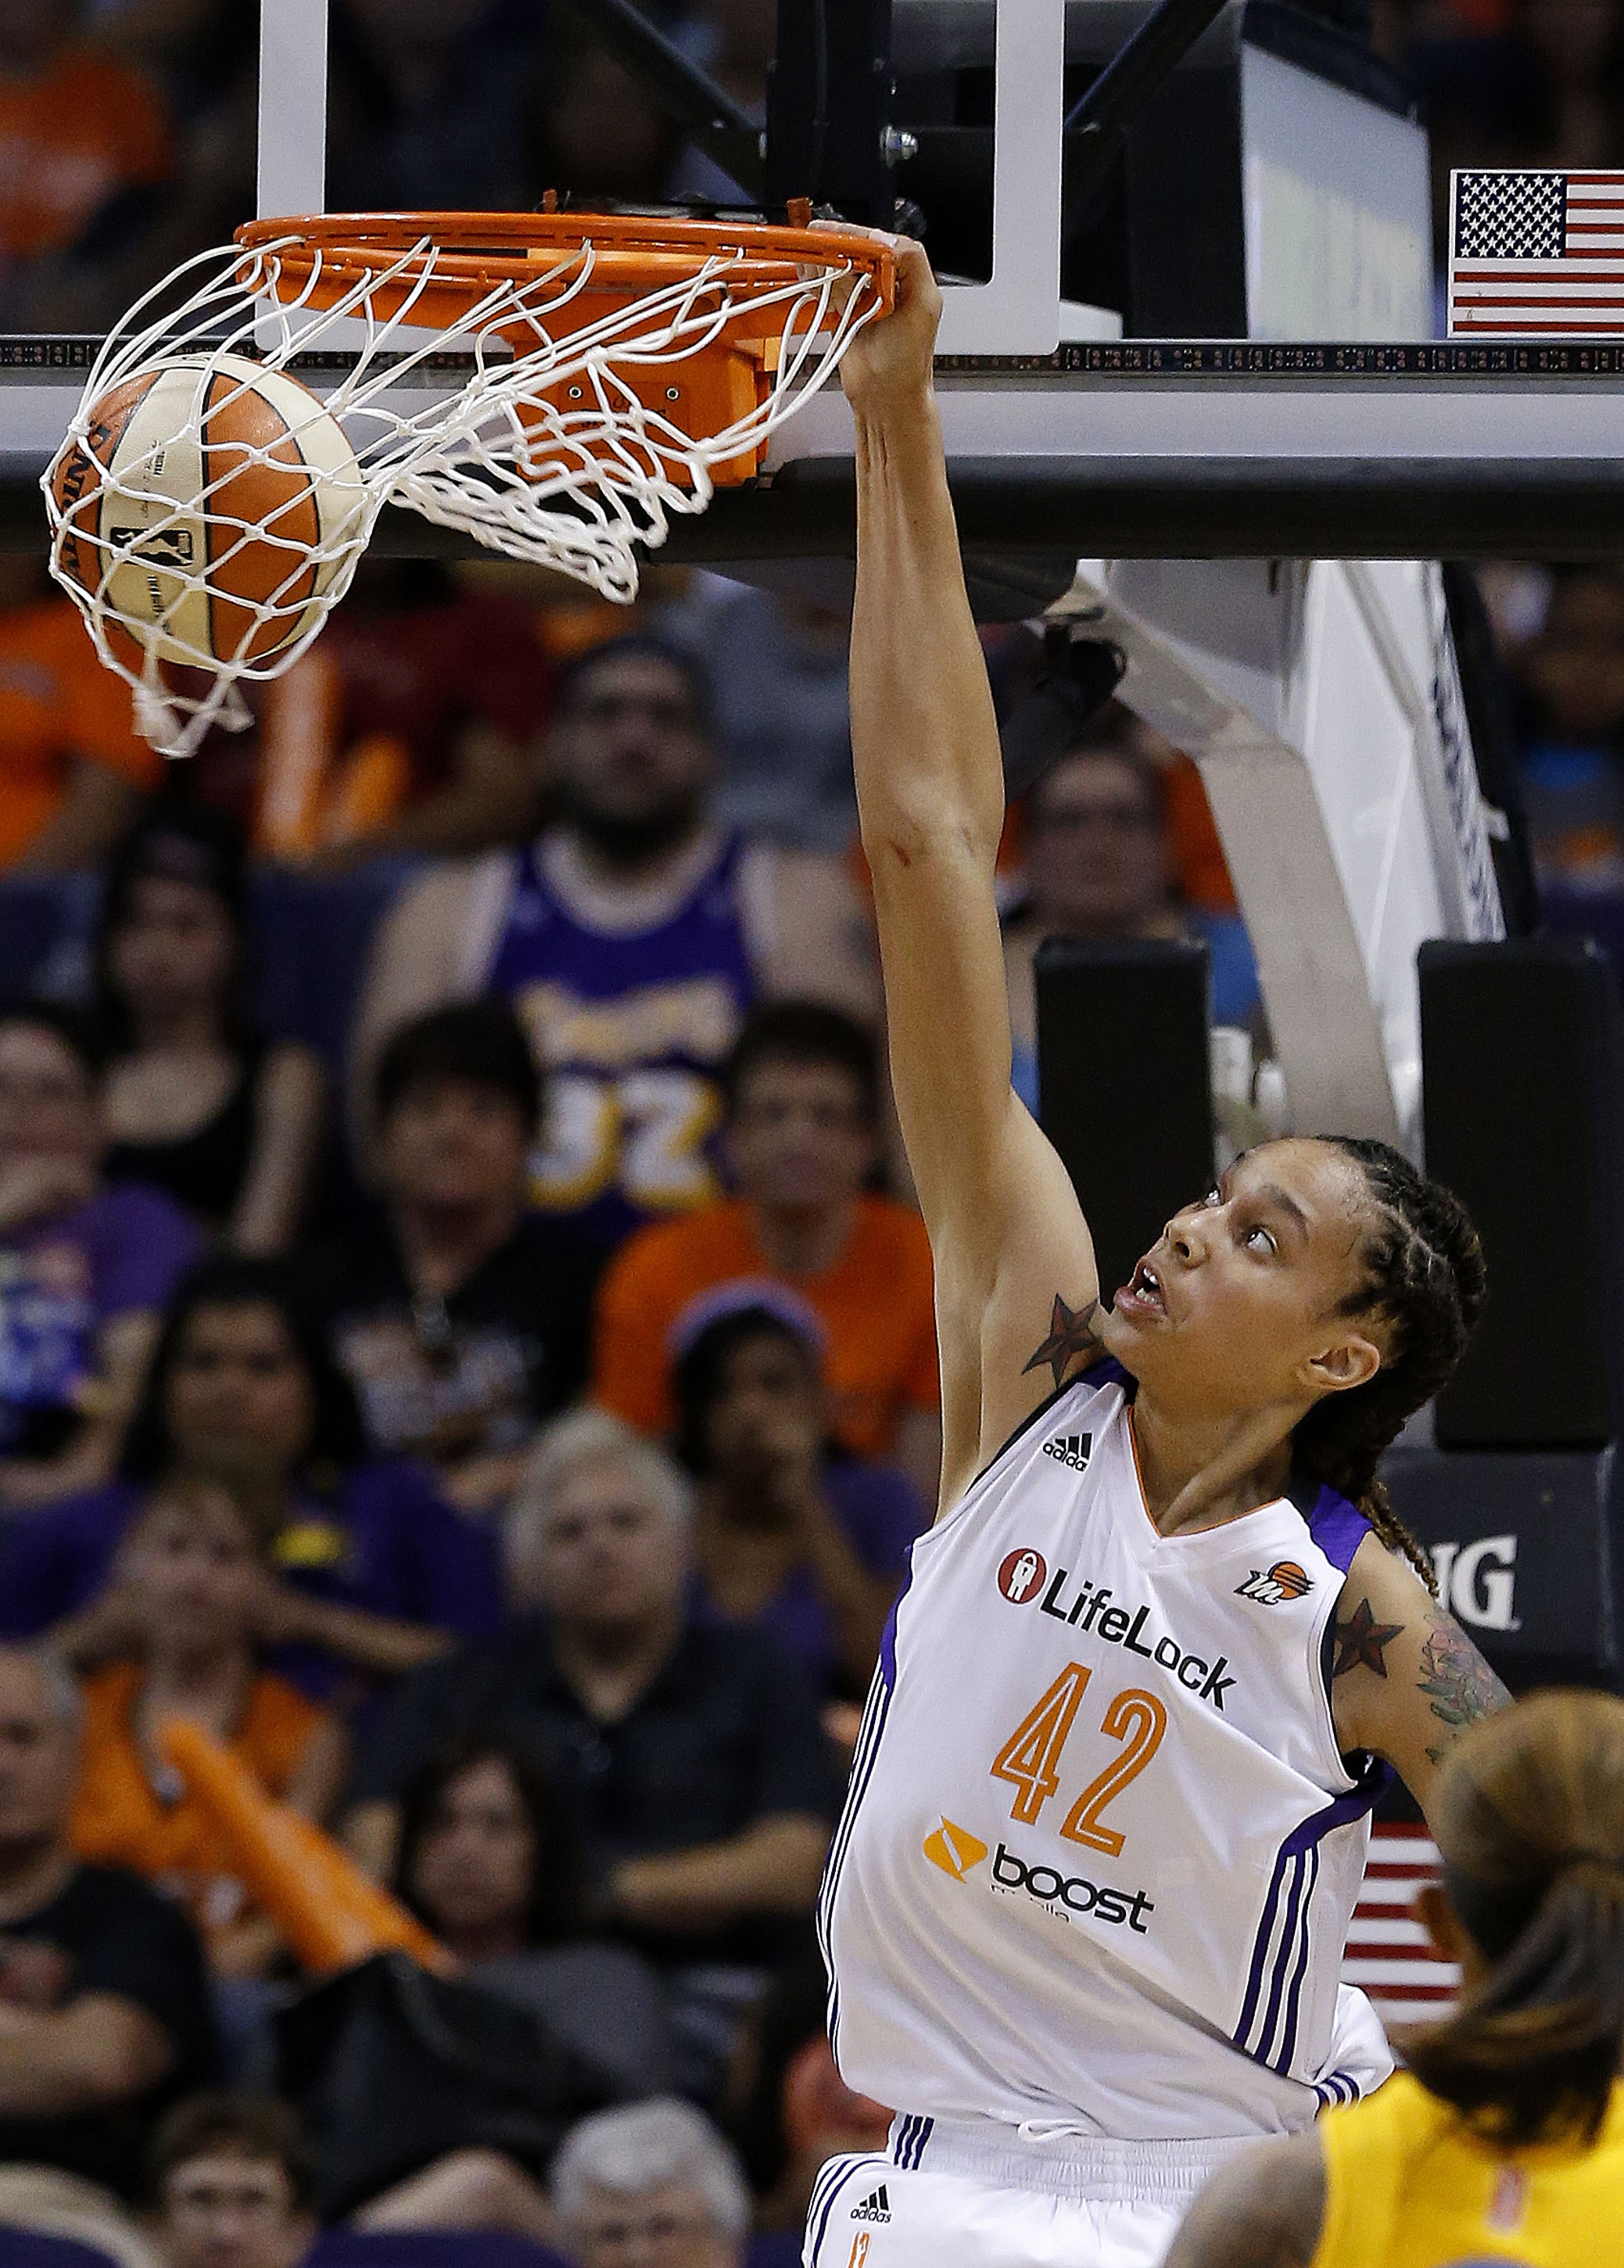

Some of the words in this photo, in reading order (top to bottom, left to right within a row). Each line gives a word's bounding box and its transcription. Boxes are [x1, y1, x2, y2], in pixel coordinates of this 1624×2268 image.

[1042, 1442, 1088, 1473] adida
[1039, 1568, 1238, 1711] LifeLock
[990, 1661, 1168, 1857] 42
[992, 1843, 1156, 1935] boost
